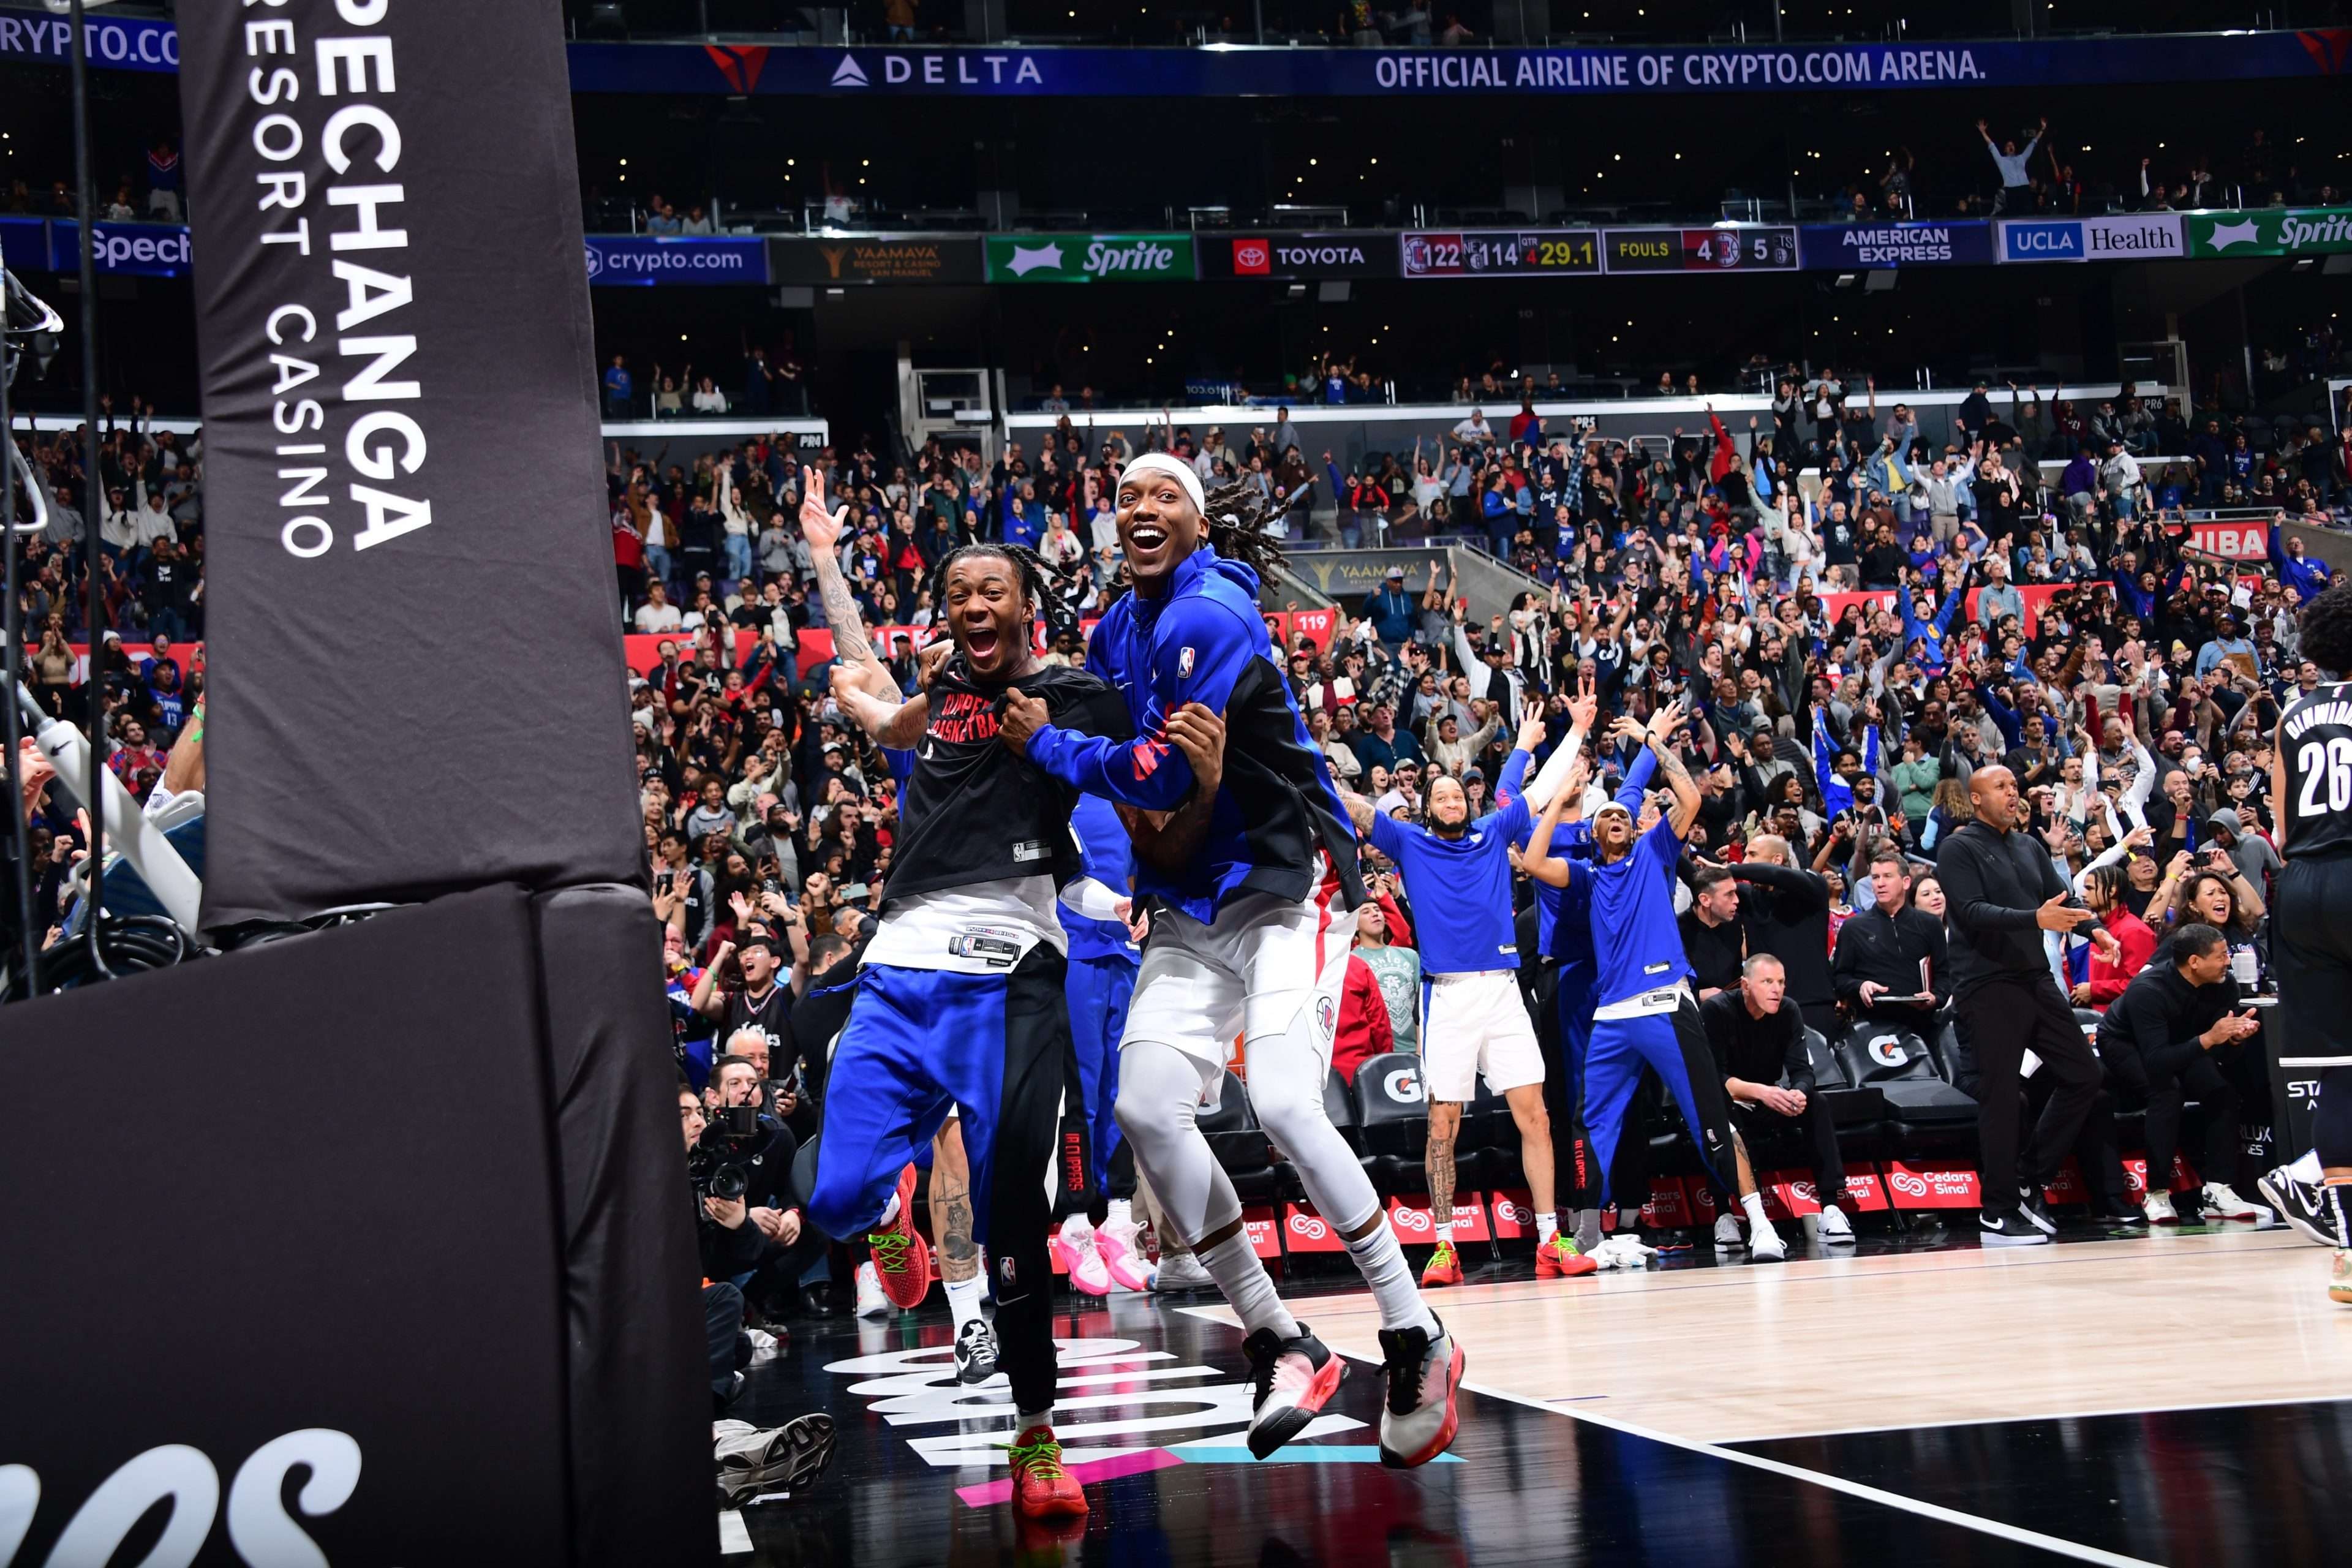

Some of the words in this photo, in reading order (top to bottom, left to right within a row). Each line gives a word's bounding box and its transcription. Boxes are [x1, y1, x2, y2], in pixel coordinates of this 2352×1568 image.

[885, 56, 1042, 83] DELTA
[1376, 58, 1507, 88] OFFICIAL
[1515, 57, 1629, 86] AIRLINE
[1637, 56, 1674, 85] OF
[1683, 53, 1870, 85] CRYPTO.COM
[1880, 50, 1986, 80] ARENA.
[243, 0, 310, 255] ESORT
[1521, 237, 1538, 246] QTR
[1842, 228, 1950, 246] AMERICAN
[2017, 232, 2075, 251] UCLA
[2090, 226, 2176, 251] Health
[92, 228, 194, 268] Spect
[1277, 247, 1365, 265] TOYOTA
[1423, 244, 1460, 266] 122
[1479, 243, 1518, 266] 114
[1526, 249, 1538, 265] 4
[1540, 241, 1593, 265] 29.1
[1619, 243, 1670, 257] FOULS
[1697, 239, 1713, 261] 4
[1754, 239, 1768, 260] 5
[1858, 246, 1952, 262] EXPRESS
[608, 251, 743, 272] crypto.com
[1083, 241, 1173, 276] Sprite
[2144, 398, 2163, 409] PR6
[266, 304, 333, 558] CASINO
[1575, 416, 1596, 429] PR5
[799, 434, 821, 448] PR4
[1298, 614, 1327, 630] 119
[166, 712, 177, 726] 13
[2285, 701, 2352, 740] DINWID
[2298, 737, 2352, 817] 26
[1868, 1035, 1909, 1067] G
[1384, 1069, 1423, 1102] G
[1843, 1175, 1874, 1187] dars
[1923, 1171, 1973, 1183] Cedars
[1652, 1190, 1681, 1201] dars
[1836, 1187, 1871, 1200] Sinai
[1934, 1182, 1969, 1194] Sinai
[1642, 1201, 1676, 1215] Sinai
[1452, 1215, 1473, 1227] nai
